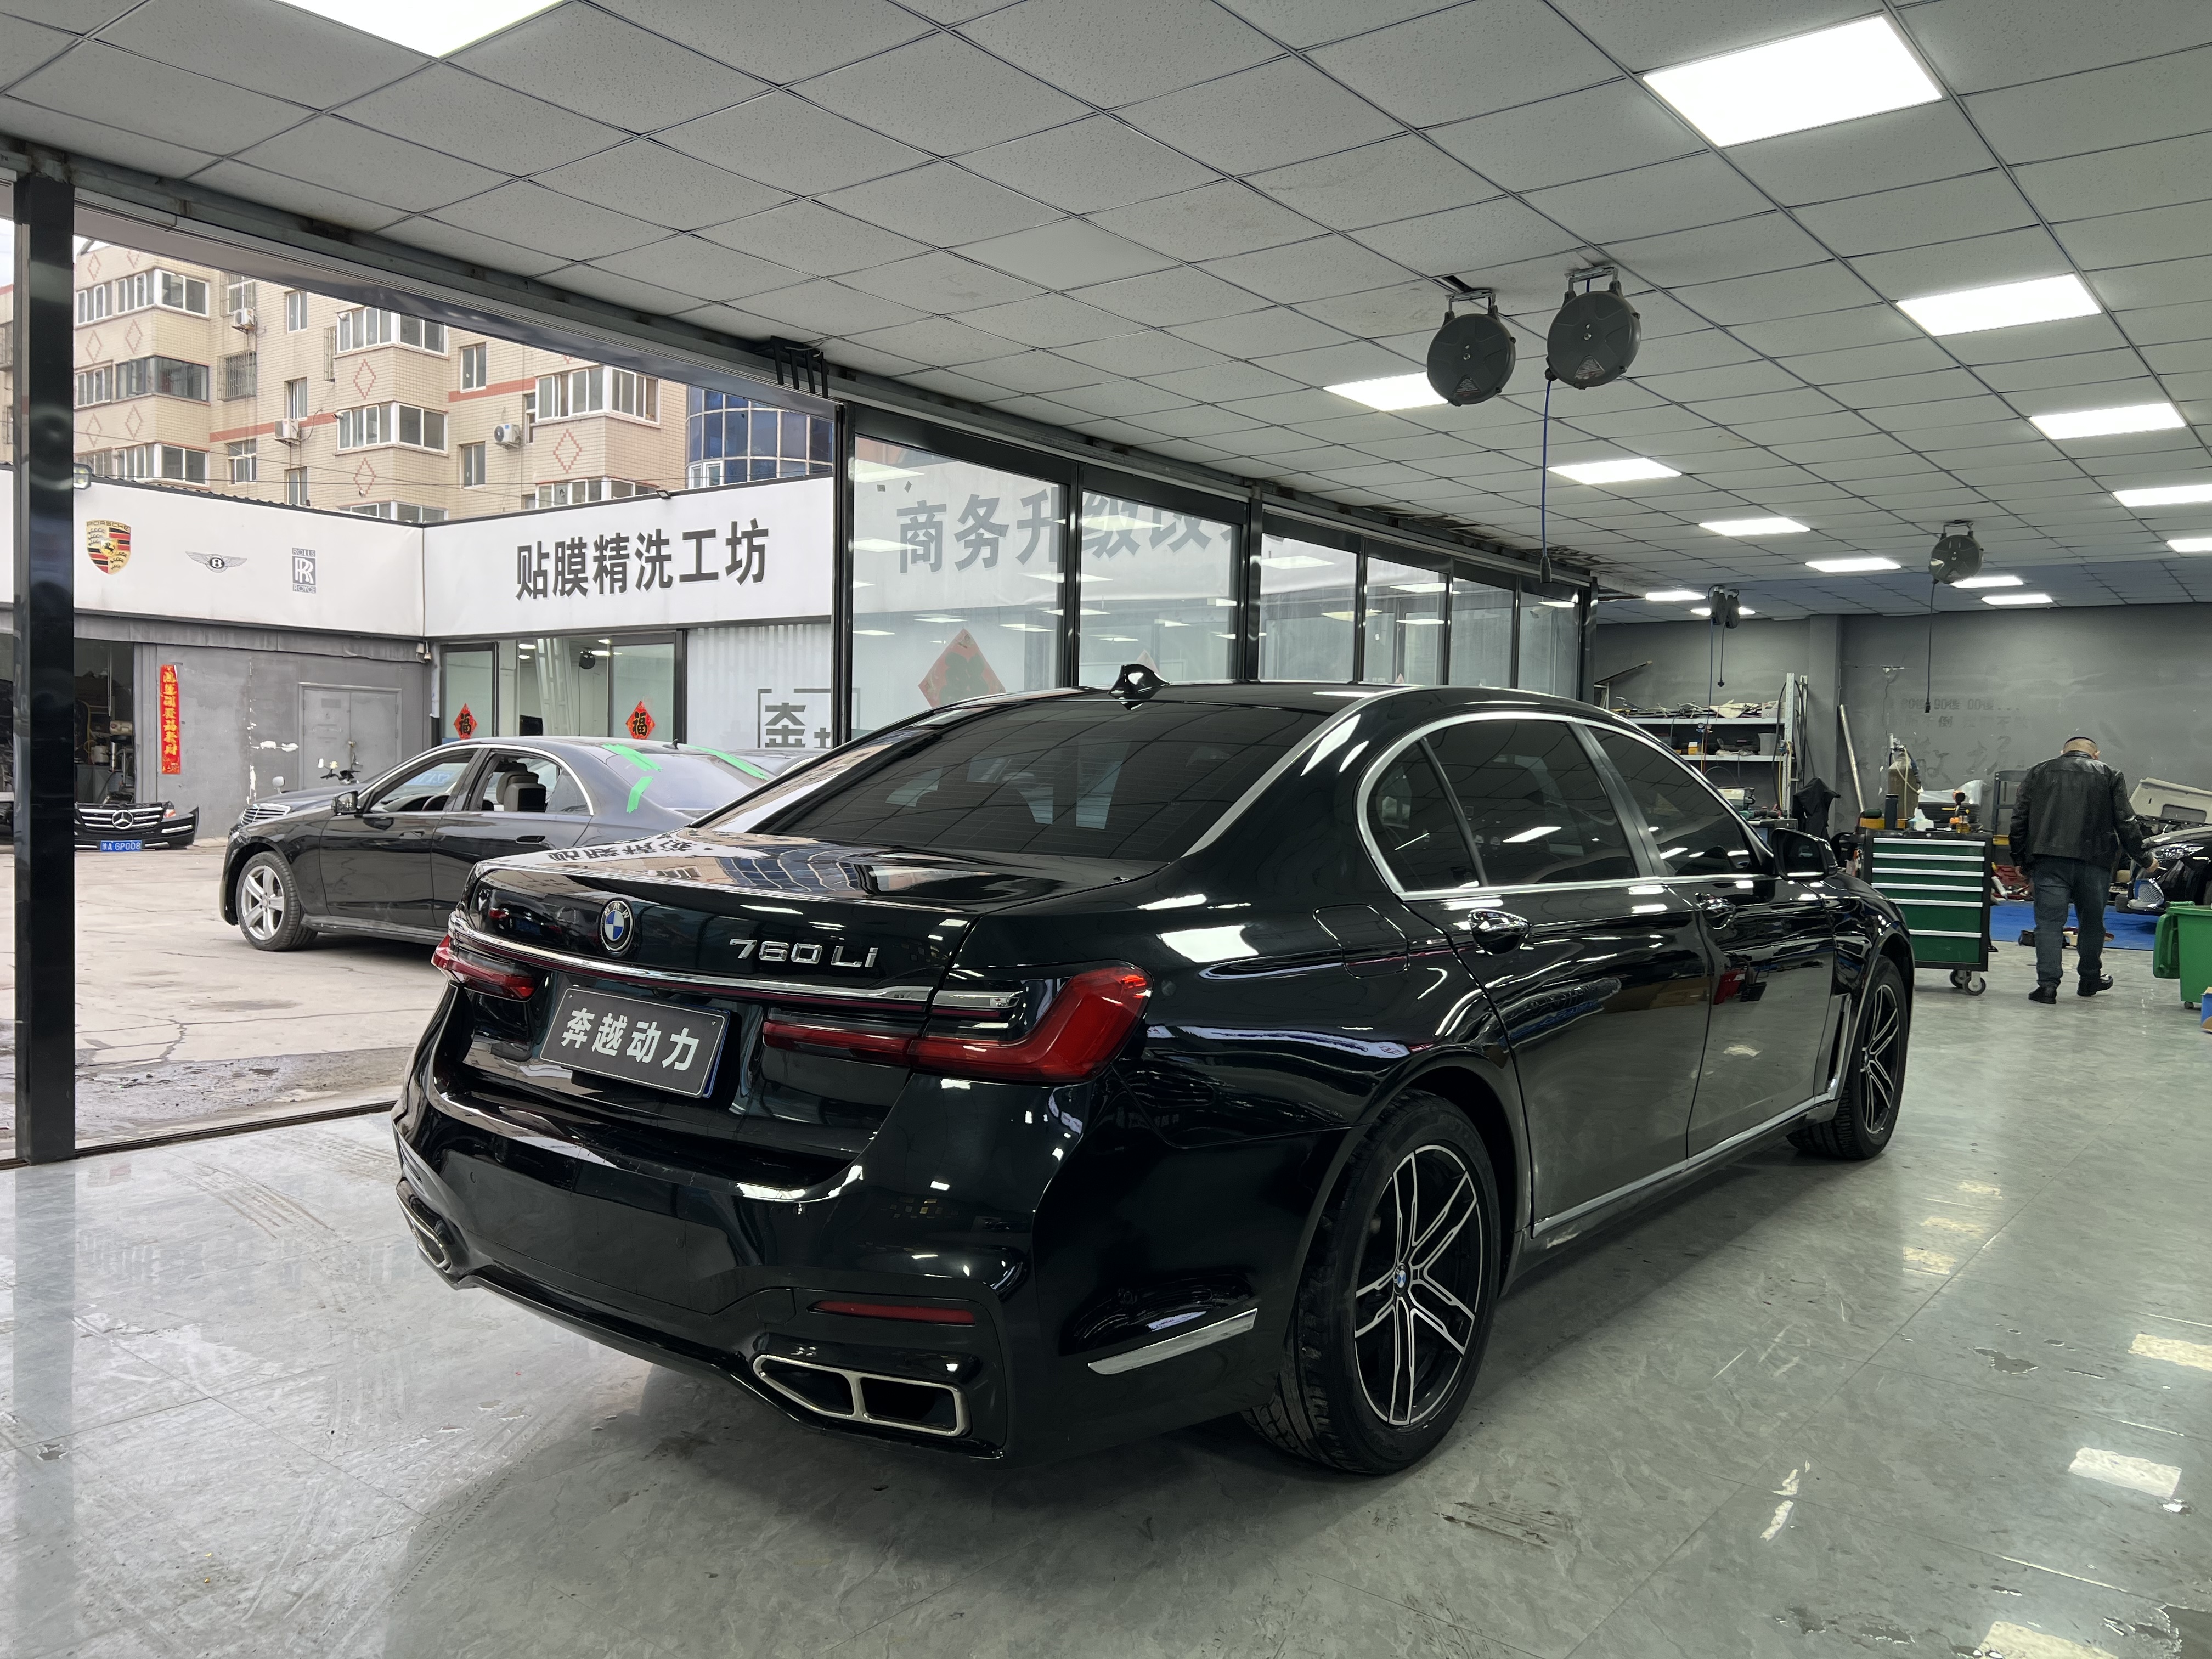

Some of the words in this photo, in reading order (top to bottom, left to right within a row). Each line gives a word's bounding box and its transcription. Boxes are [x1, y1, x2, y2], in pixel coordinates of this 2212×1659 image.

[87, 521, 129, 532] PORSCHE
[896, 488, 1232, 574] 商务升级改
[211, 558, 223, 568] B
[294, 549, 315, 557] ROLLS
[515, 518, 769, 601] 贴膜精洗工坊
[459, 713, 471, 735] 福
[633, 710, 648, 736] 福
[605, 902, 630, 919] BMW
[729, 939, 823, 964] 760
[561, 1008, 699, 1071] 奔越动力
